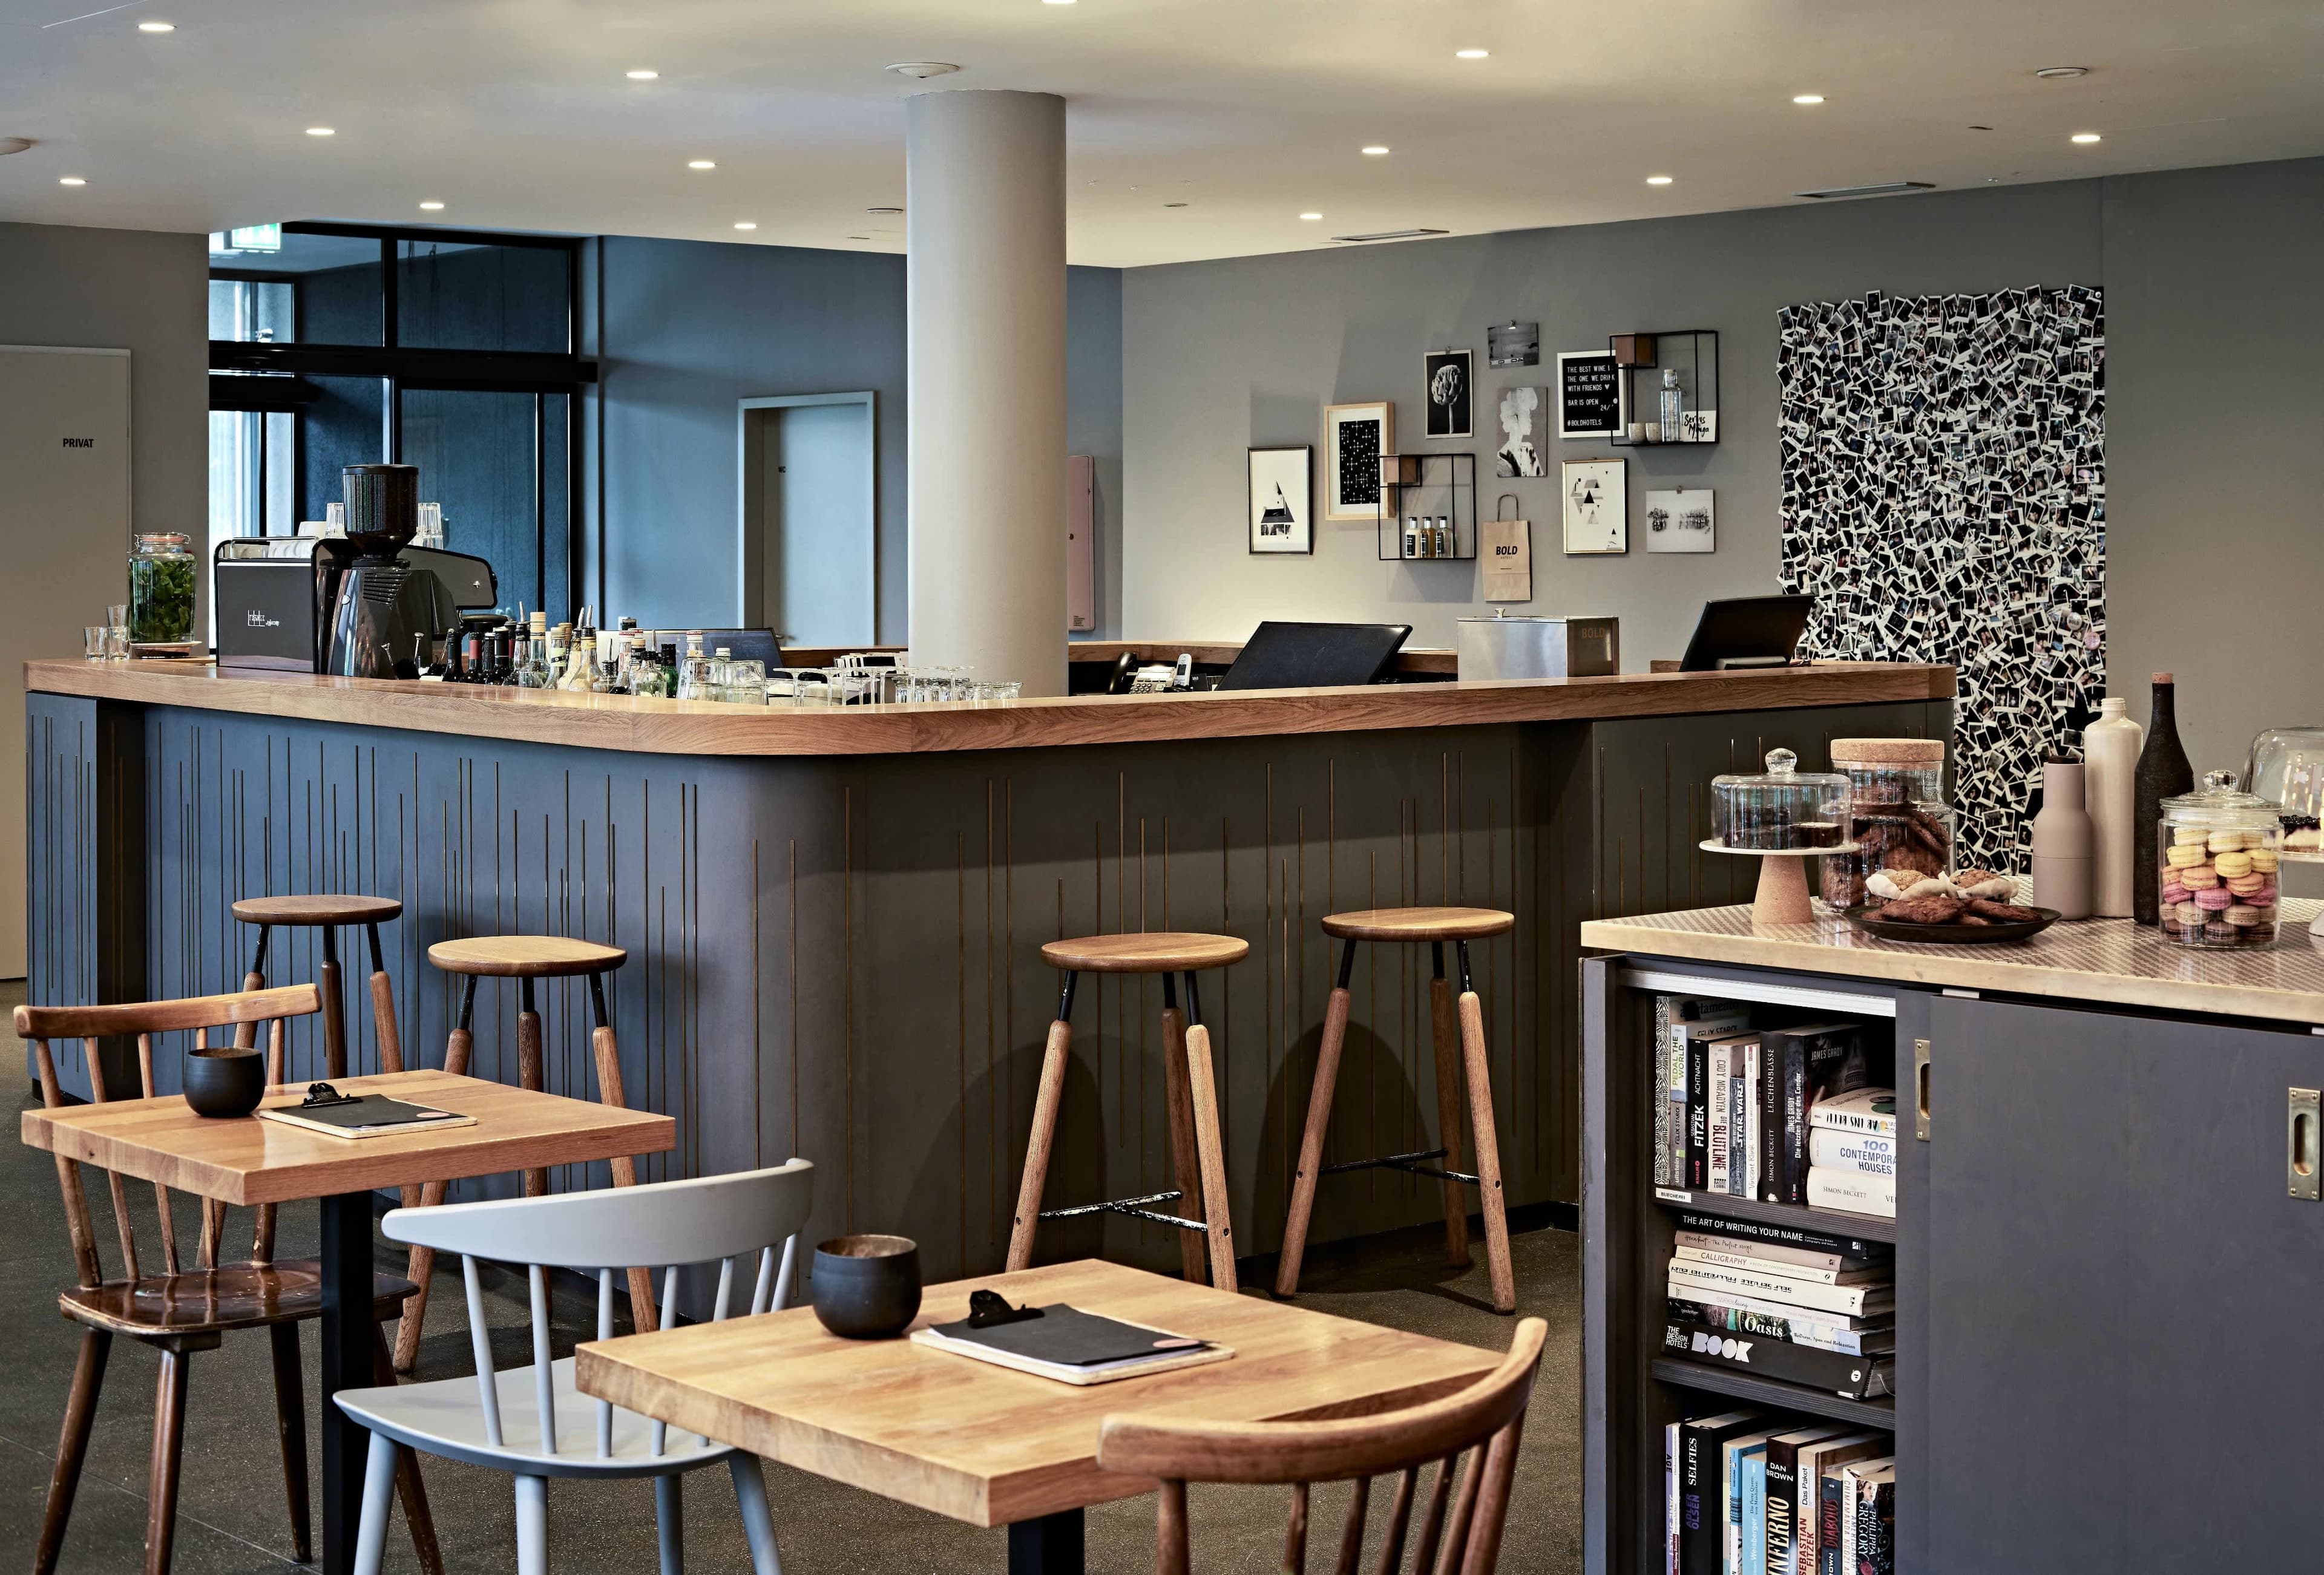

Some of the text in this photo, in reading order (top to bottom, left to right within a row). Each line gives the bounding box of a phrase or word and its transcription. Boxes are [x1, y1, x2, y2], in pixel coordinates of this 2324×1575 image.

[1684, 414, 1705, 427] Serus
[63, 438, 94, 448] PRIVAT
[1496, 546, 1518, 555] BOLD
[1582, 628, 1605, 639] BOLD
[1811, 1047, 1843, 1061] JAMES GRADY
[1716, 1060, 1726, 1113] CODY MCFADYEN
[1695, 1104, 1704, 1147] FITZEK
[1851, 1116, 1863, 1128] INS
[1712, 1125, 1727, 1170] BLUTLINIE
[1863, 1140, 1888, 1152] 100
[1840, 1147, 1896, 1165] CONTEMPORA
[1859, 1161, 1892, 1174] HOUSES
[1661, 1191, 1686, 1200] BUECHEREI
[1823, 1186, 1866, 1199] SIMON BECKETT
[1683, 1215, 1697, 1225] THE
[1699, 1218, 1713, 1227] ART
[1726, 1222, 1758, 1234] WRITING
[1759, 1227, 1779, 1238] YOUR
[1781, 1231, 1803, 1241] NAME
[1722, 1240, 1738, 1250] Perfect
[1701, 1252, 1747, 1266] CALLIGRAPHY
[1741, 1279, 1772, 1290] SERVICE
[1773, 1285, 1791, 1294] SELF
[1745, 1316, 1784, 1338] Oasis
[1666, 1338, 1687, 1349] HOTELS
[1667, 1332, 1689, 1342] DESIGN
[1692, 1331, 1754, 1363] BOOK
[1833, 1340, 1856, 1349] Relaxation
[1689, 1438, 1697, 1486] SELFIES
[1770, 1462, 1787, 1472] DAN
[1766, 1469, 1793, 1481] BROWN
[1824, 1498, 1839, 1549] DIABOLUS
[1768, 1497, 1790, 1575] INFERNO
[1858, 1501, 1869, 1561] GREGORY
